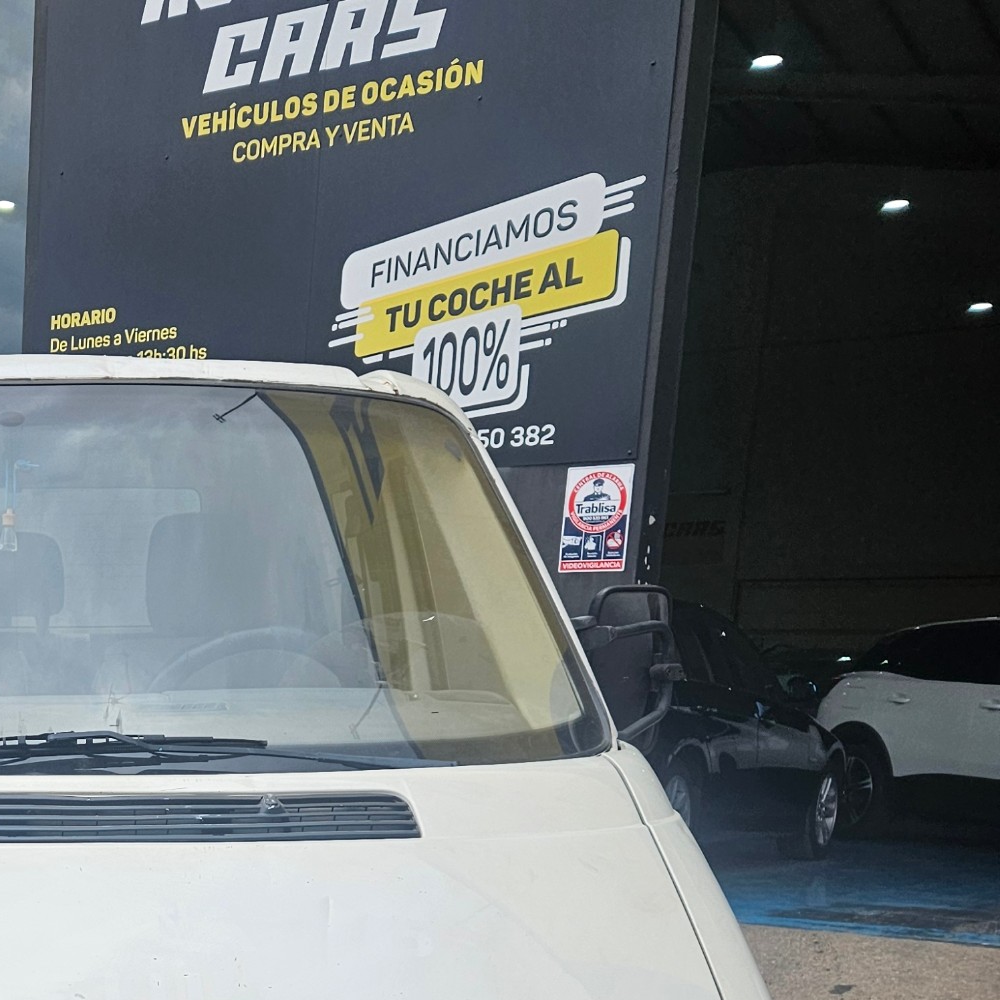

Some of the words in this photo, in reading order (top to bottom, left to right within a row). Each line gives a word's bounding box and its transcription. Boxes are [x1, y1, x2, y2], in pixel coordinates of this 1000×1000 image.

[202, 0, 447, 94] CARS
[181, 92, 318, 139] VEHÍCULOS
[322, 85, 356, 114] DE
[361, 58, 485, 106] OCASIÓN
[232, 130, 321, 163] COMPRA
[325, 126, 340, 147] Y
[342, 112, 415, 145] VENTA
[370, 199, 579, 289] FINANCIAMOS
[385, 299, 422, 333] TU
[428, 268, 534, 323] COCHE
[538, 257, 584, 295] AL
[50, 307, 117, 330] HORARIO
[50, 337, 68, 353] De
[70, 335, 111, 351] Lunes
[113, 332, 122, 346] a
[124, 326, 178, 344] Viernes
[189, 344, 208, 360] hs
[422, 318, 512, 397] 100%
[509, 423, 556, 447] 382
[573, 472, 596, 493] CENTRAL
[575, 502, 617, 514] Trablisa
[562, 561, 622, 570] VIDEOVIGILANCIA
